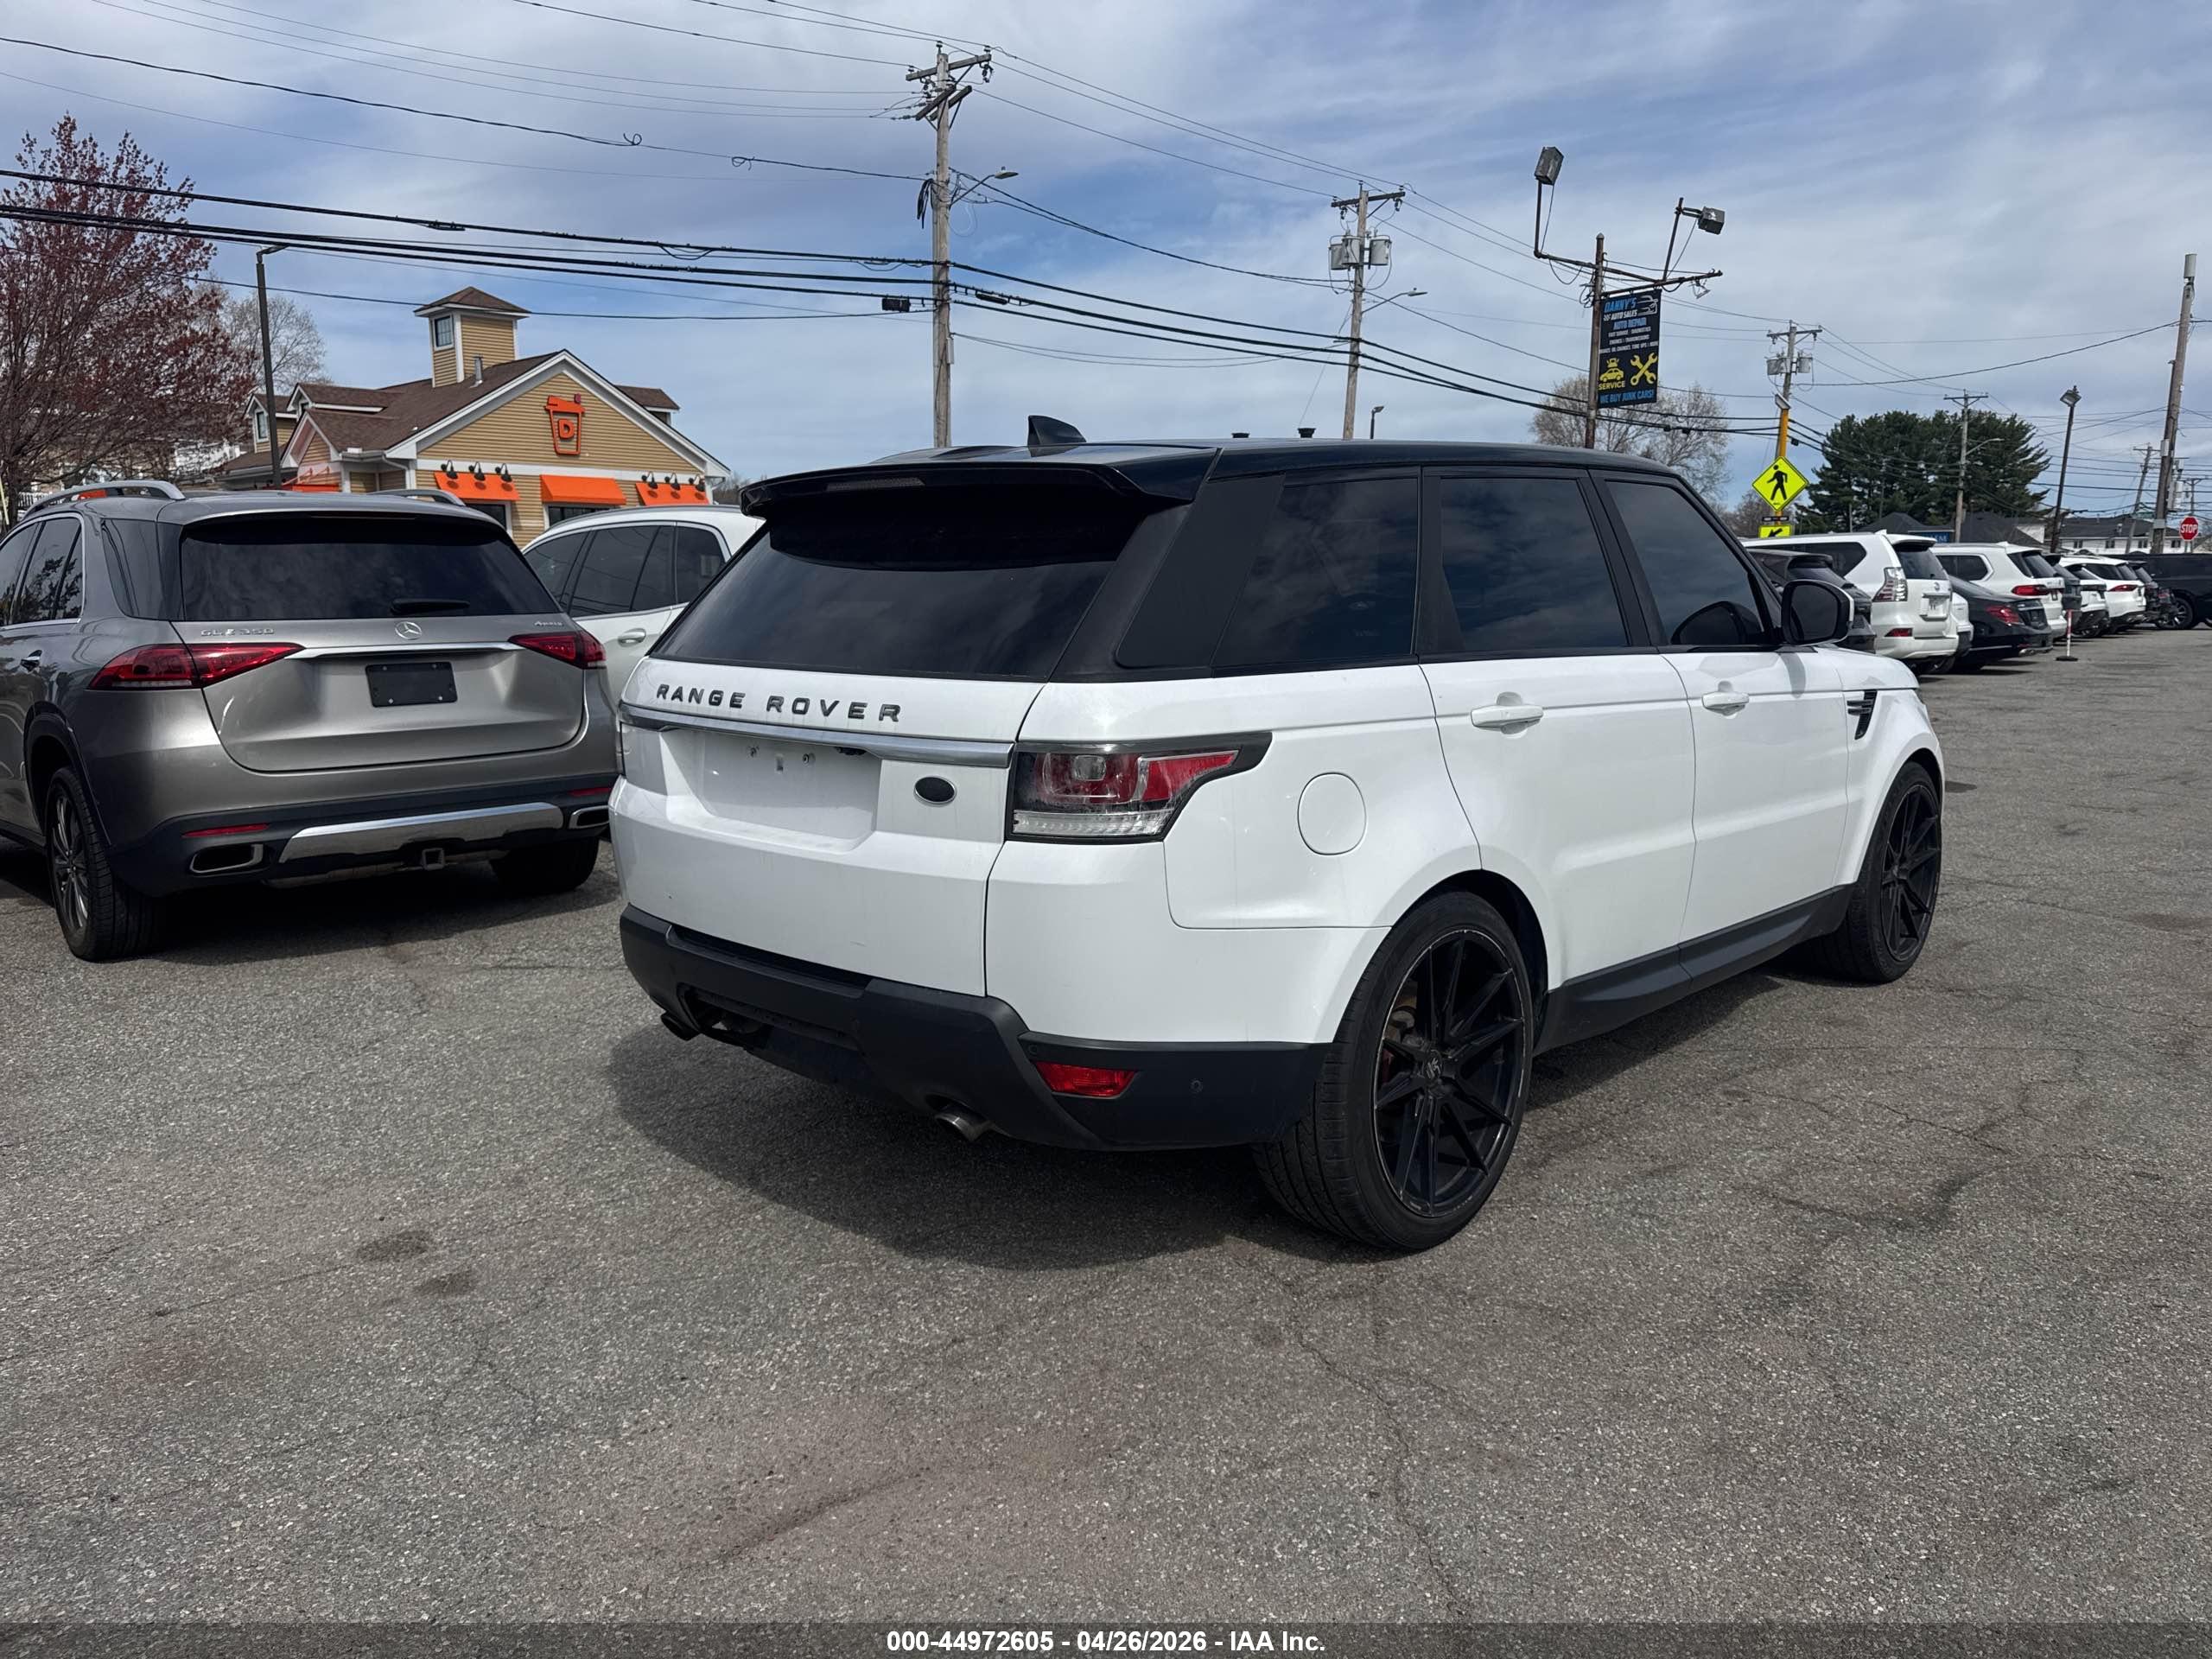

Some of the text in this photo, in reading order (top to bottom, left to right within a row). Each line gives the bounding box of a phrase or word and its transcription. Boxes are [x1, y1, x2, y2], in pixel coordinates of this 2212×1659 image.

[1604, 297, 1637, 313] DANNY'S
[1611, 309, 1638, 321] AUTO SALES
[1598, 380, 1626, 391] SERVICE
[558, 418, 575, 439] D
[2181, 524, 2198, 534] STOP
[656, 683, 901, 722] RANGE ROVER
